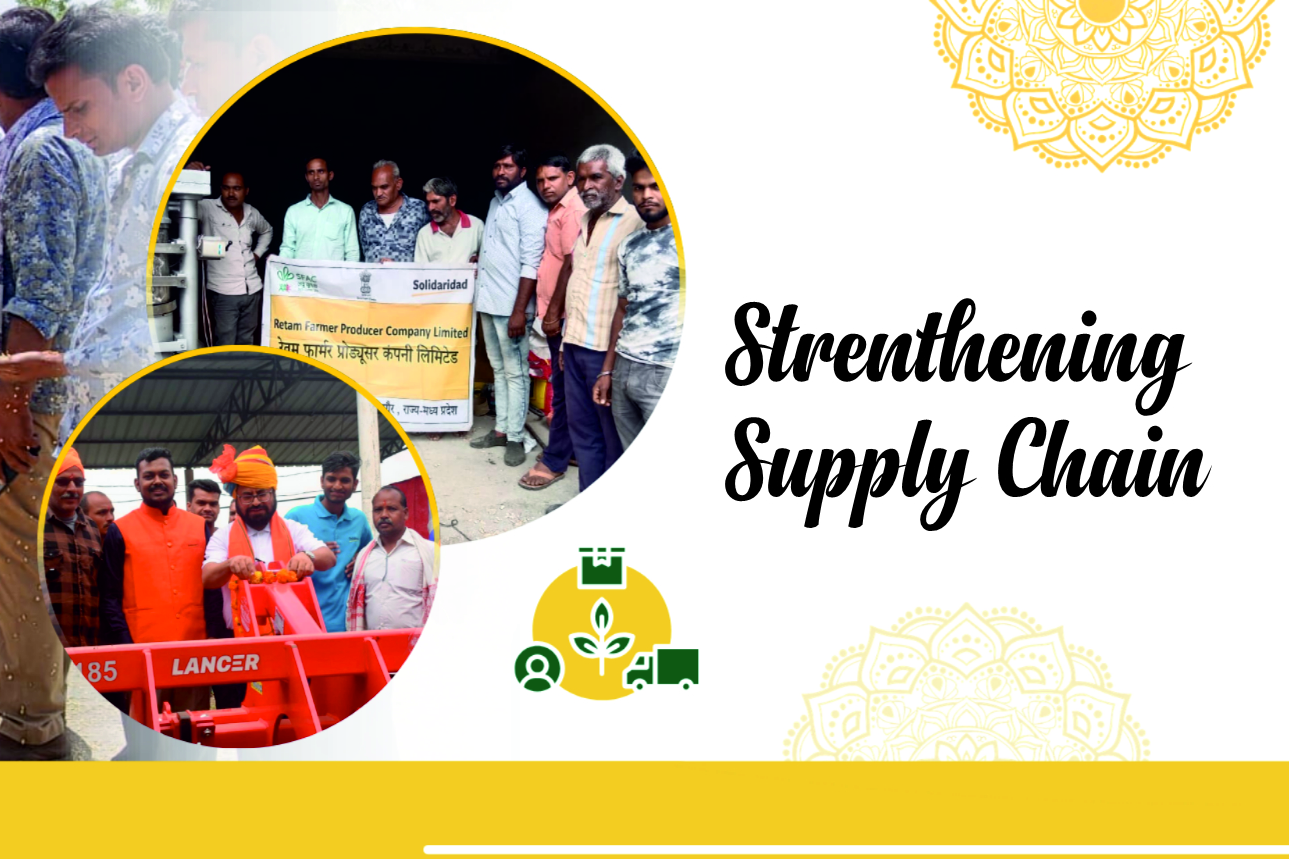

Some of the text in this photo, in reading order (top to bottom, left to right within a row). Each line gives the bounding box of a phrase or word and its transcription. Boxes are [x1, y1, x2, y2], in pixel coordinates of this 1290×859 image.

[296, 273, 317, 283] SFAC
[413, 279, 468, 291] Solidaridad
[273, 318, 469, 339] Retam Farmer Producer Company Limited
[303, 340, 333, 358] फार्मर
[337, 340, 379, 364] प्रोड्यूसर
[382, 344, 413, 362] कंपनी
[416, 344, 459, 364] लिमिटेड
[440, 402, 459, 416] प्रदेश
[172, 653, 260, 676] LANCER
